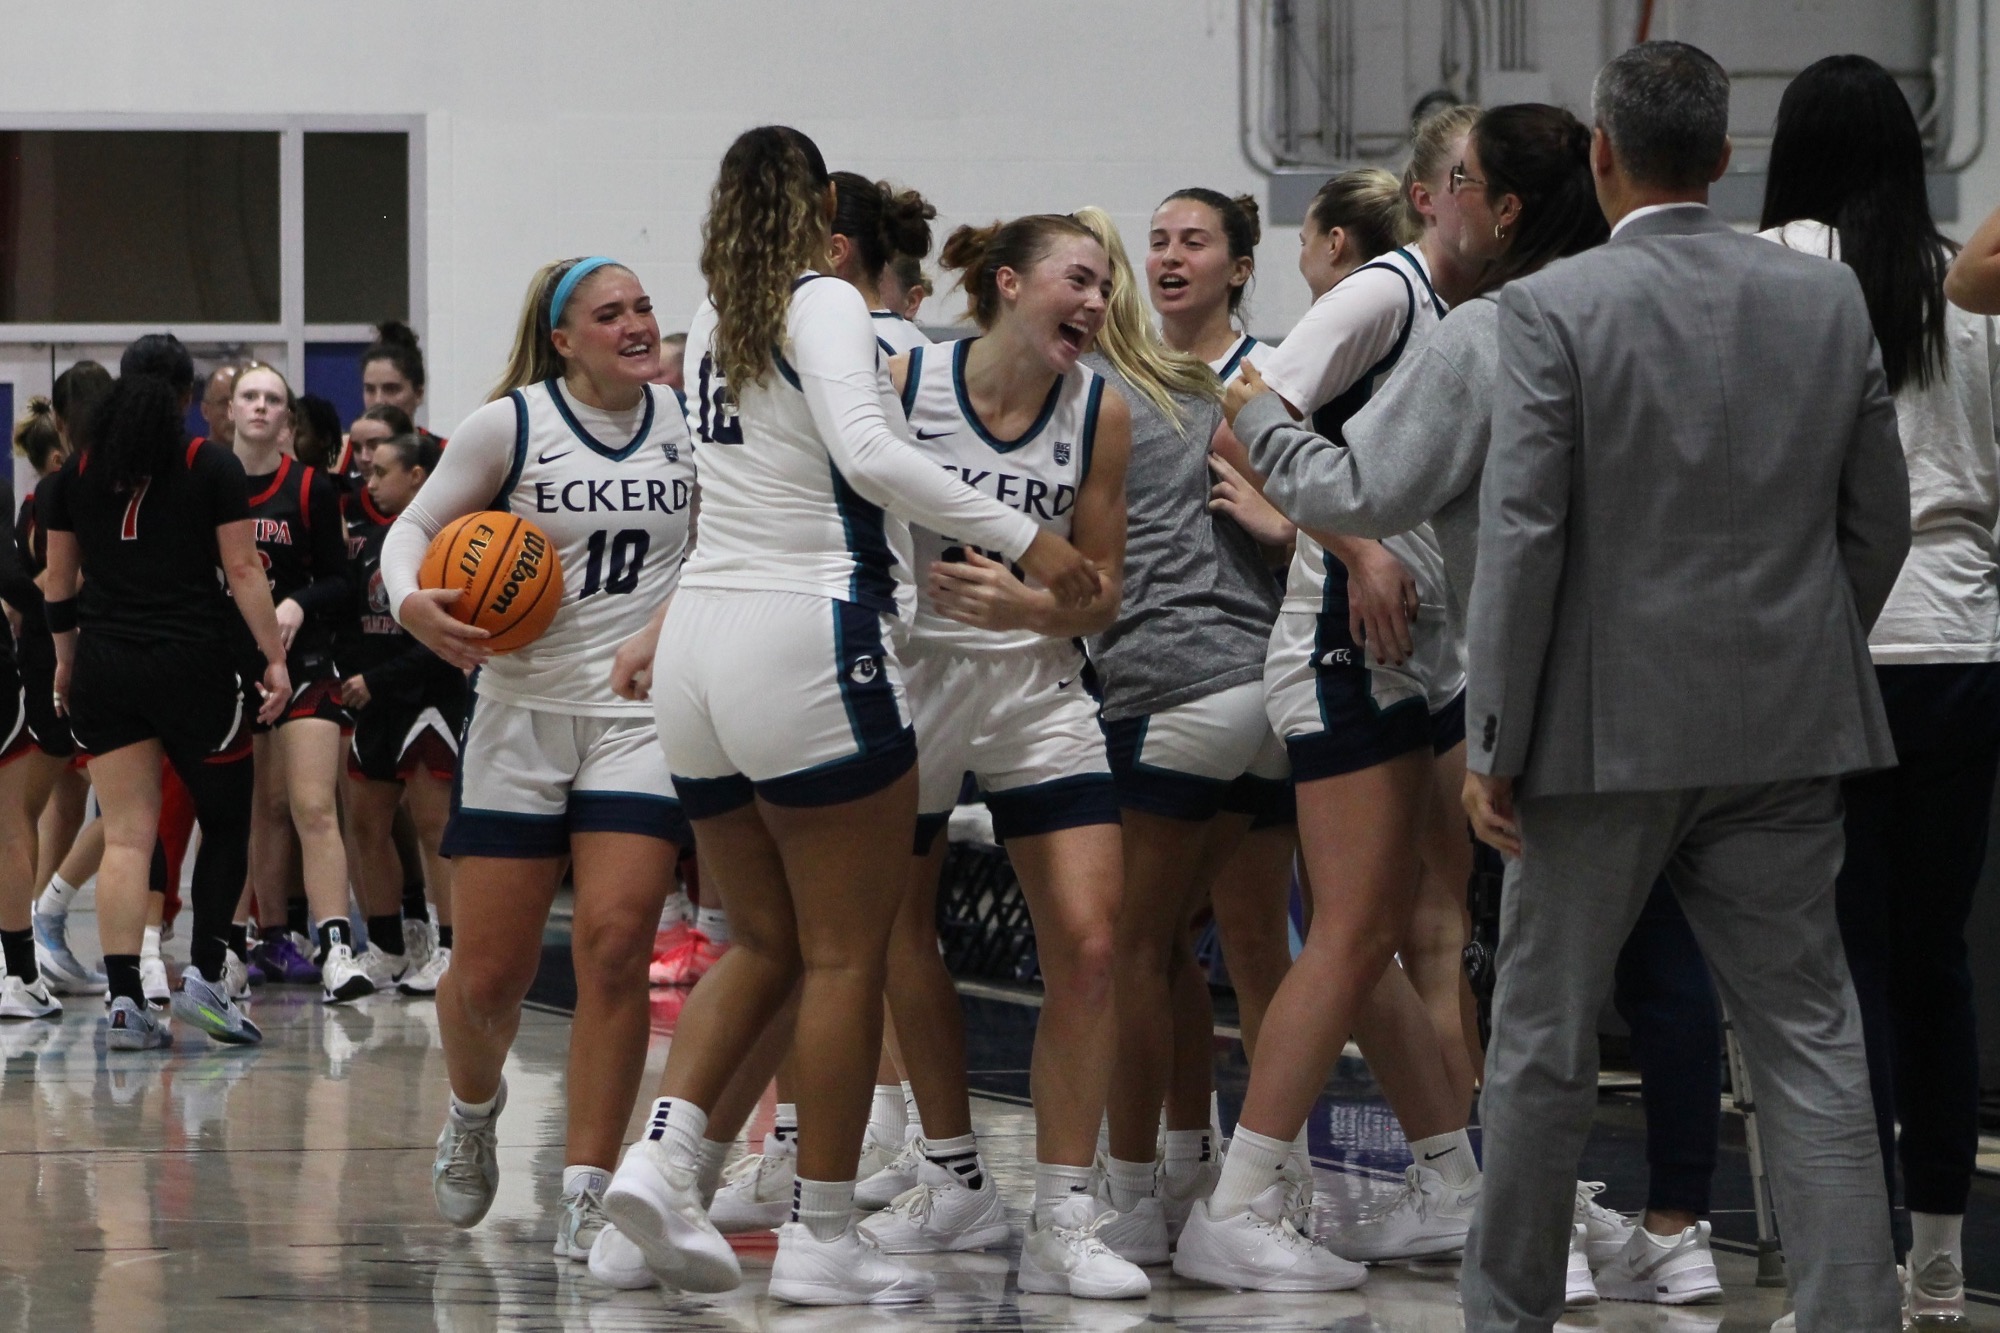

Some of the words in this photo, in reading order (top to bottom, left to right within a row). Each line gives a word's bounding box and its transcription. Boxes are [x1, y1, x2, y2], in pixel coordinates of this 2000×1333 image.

[535, 479, 688, 514] ECKERD
[490, 531, 546, 615] Wilson
[579, 529, 650, 600] 10
